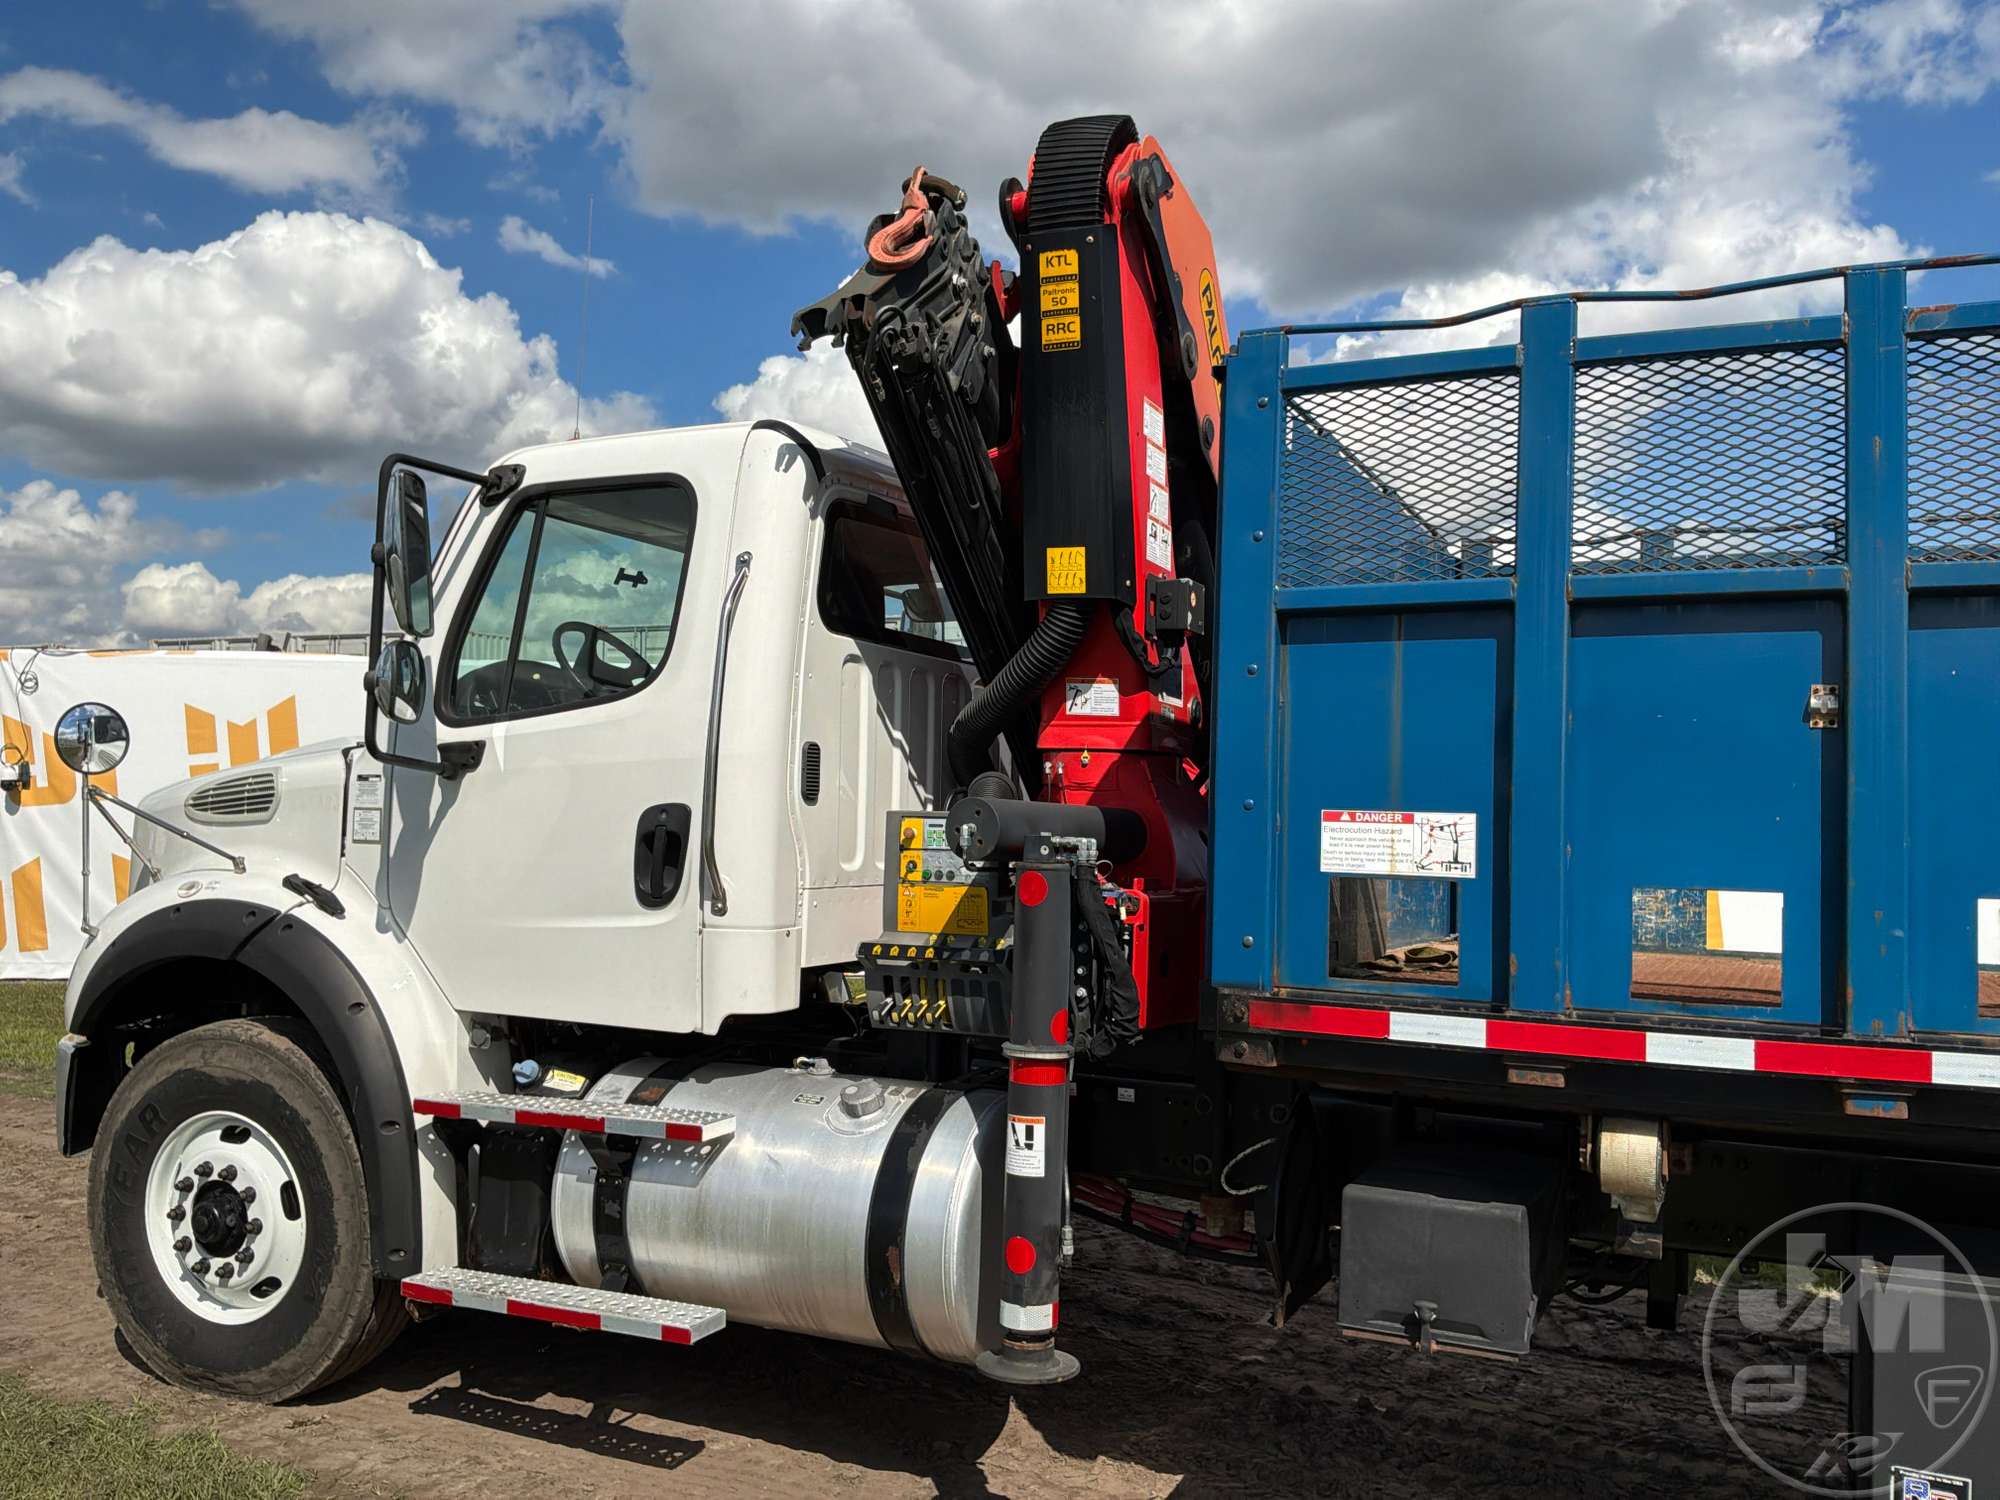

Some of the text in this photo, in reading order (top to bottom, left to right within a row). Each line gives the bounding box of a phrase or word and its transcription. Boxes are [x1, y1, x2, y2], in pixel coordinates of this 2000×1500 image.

[1046, 254, 1072, 268] KTL
[1051, 296, 1068, 307] 50
[1046, 322, 1076, 336] RRC
[1356, 813, 1402, 822] DANGER
[1374, 827, 1402, 835] Hazard
